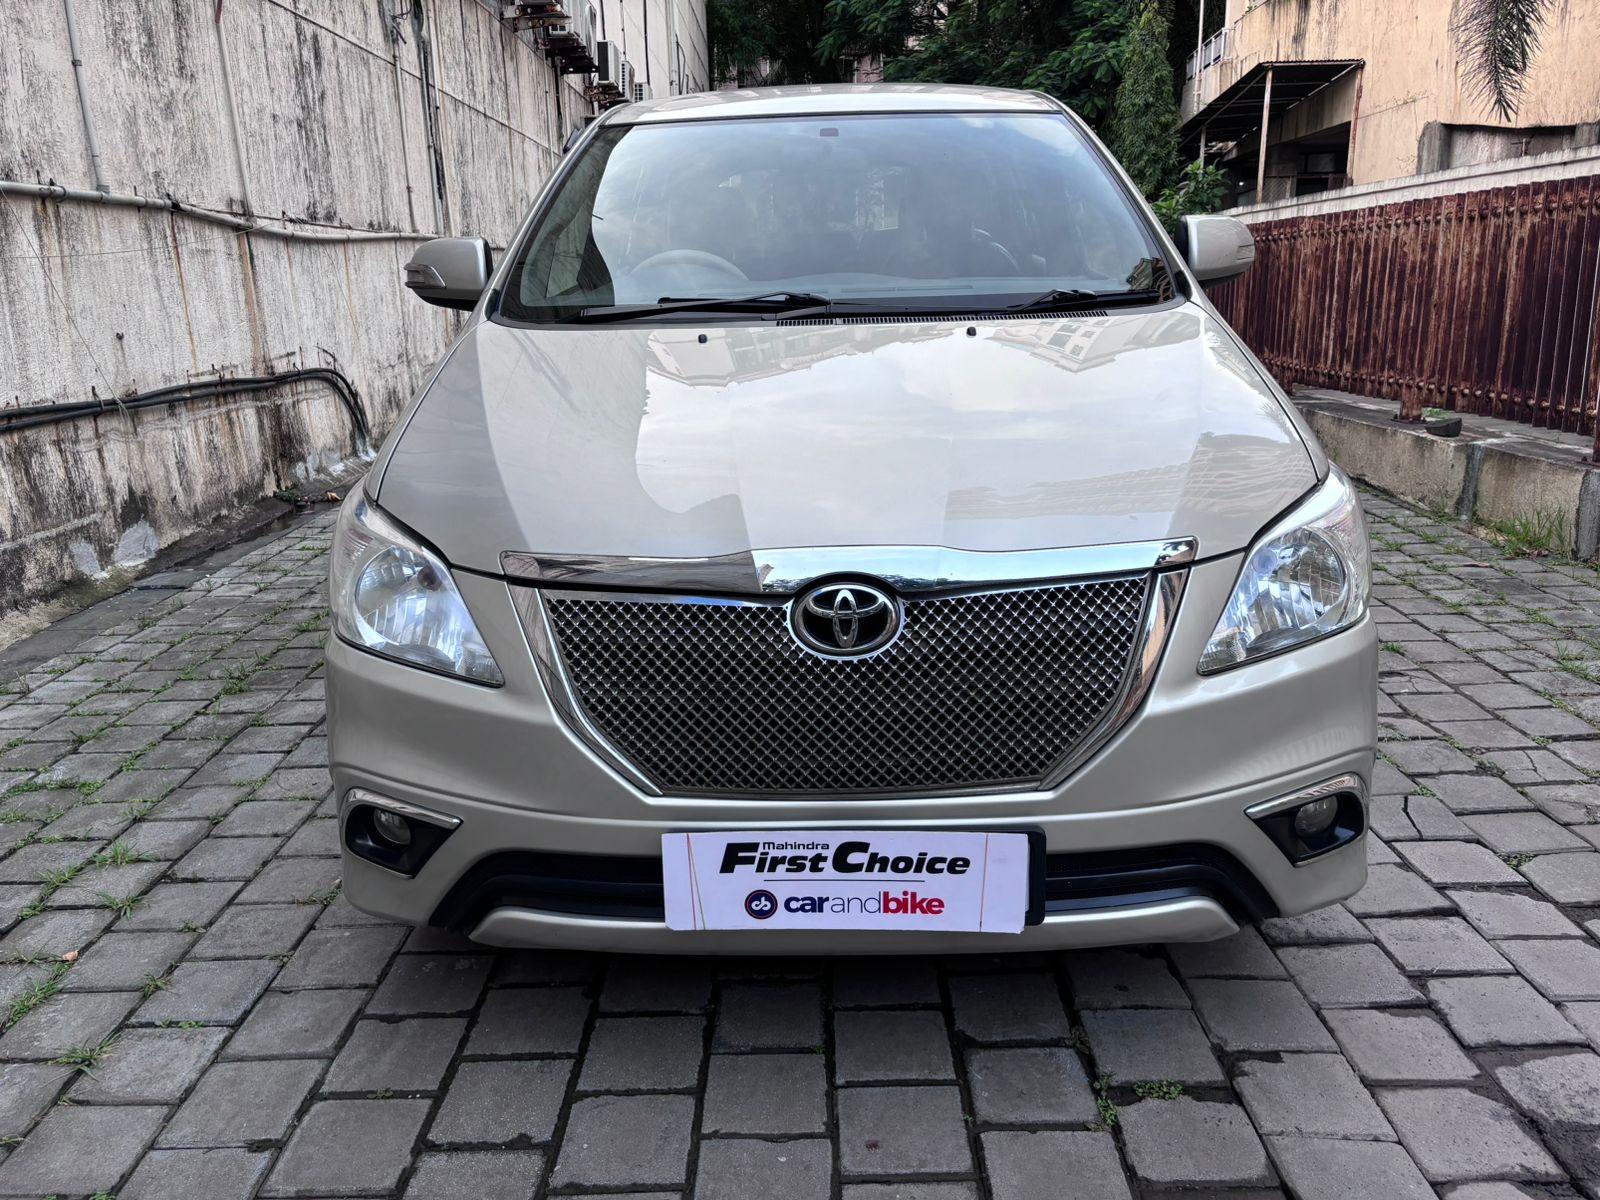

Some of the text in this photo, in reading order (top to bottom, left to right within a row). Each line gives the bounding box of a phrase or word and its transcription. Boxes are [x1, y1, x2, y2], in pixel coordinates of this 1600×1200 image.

[762, 841, 830, 850] Mahindra
[719, 841, 971, 875] First Choice
[783, 891, 945, 915] carandbike
